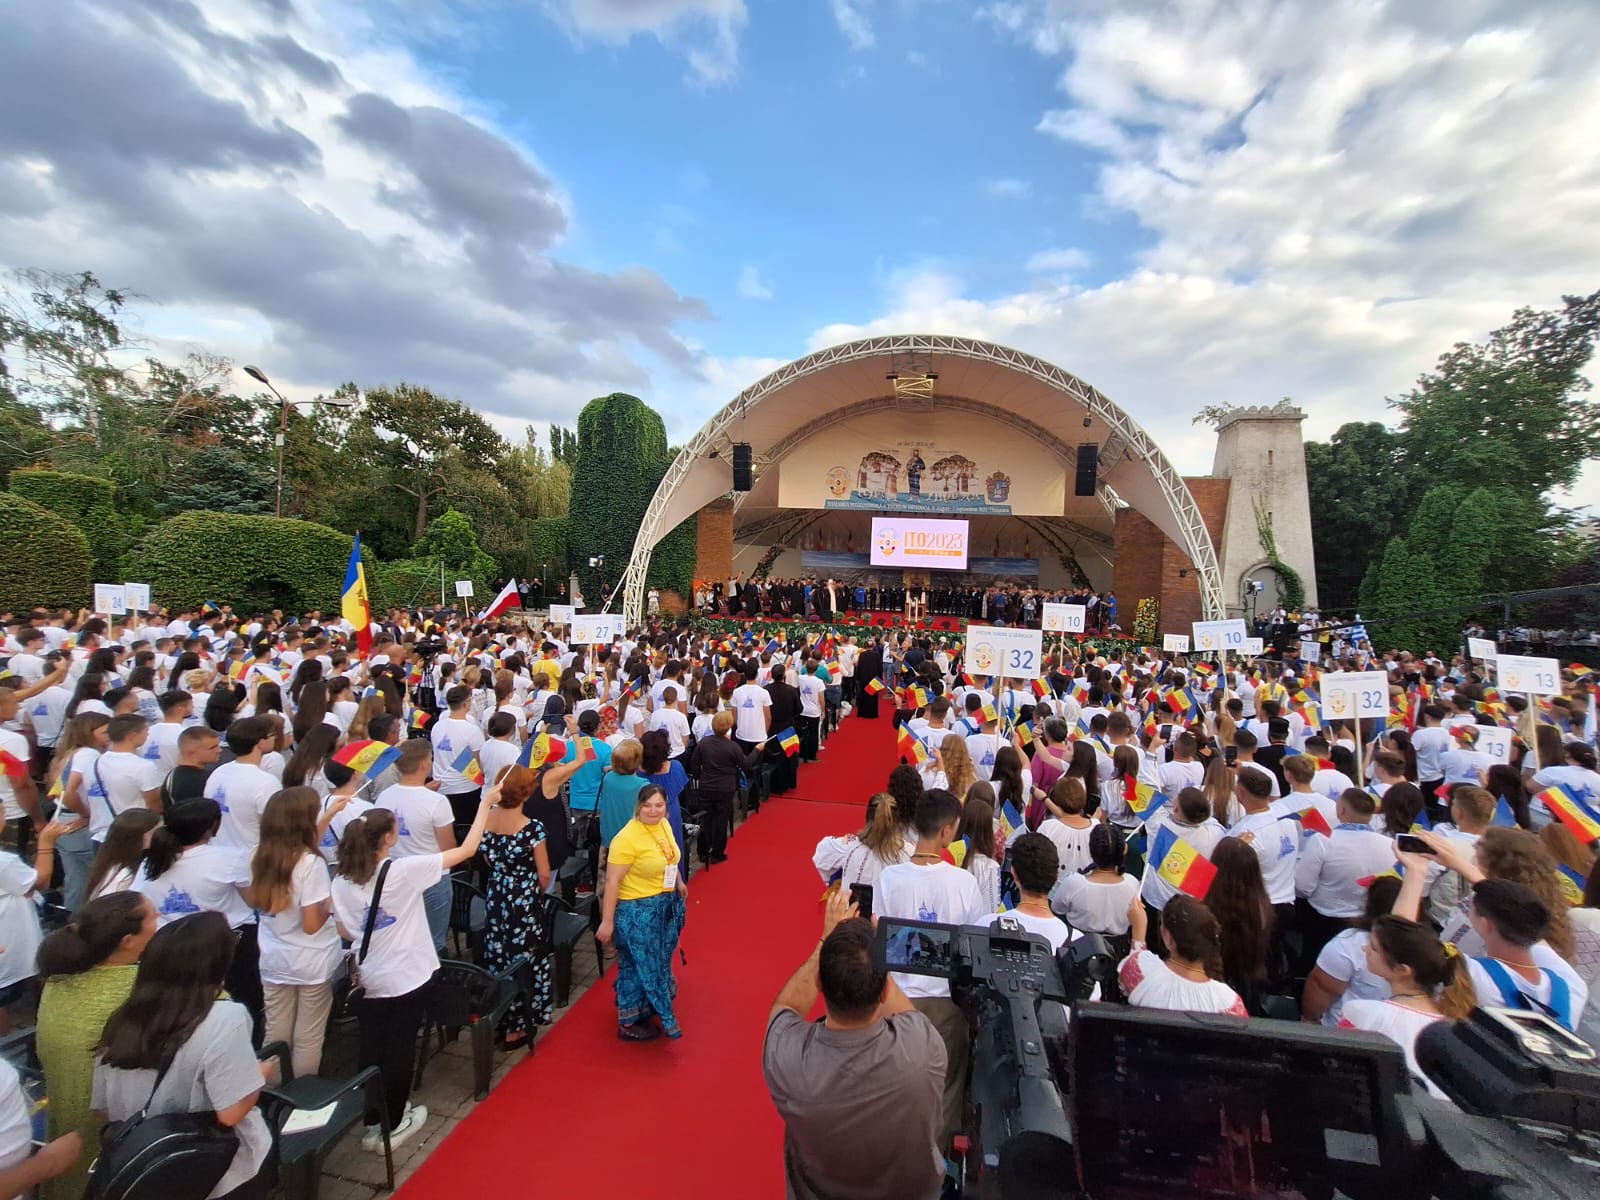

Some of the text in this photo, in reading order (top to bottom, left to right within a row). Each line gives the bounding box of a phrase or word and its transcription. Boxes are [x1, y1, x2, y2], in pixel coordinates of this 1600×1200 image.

[112, 597, 122, 609] 24
[1068, 616, 1081, 627] 10
[595, 626, 609, 639] 27
[1225, 632, 1242, 644] 10
[1010, 649, 1034, 670] 32
[1535, 673, 1555, 688] 13
[1362, 690, 1383, 709] 32
[1486, 742, 1504, 757] 13
